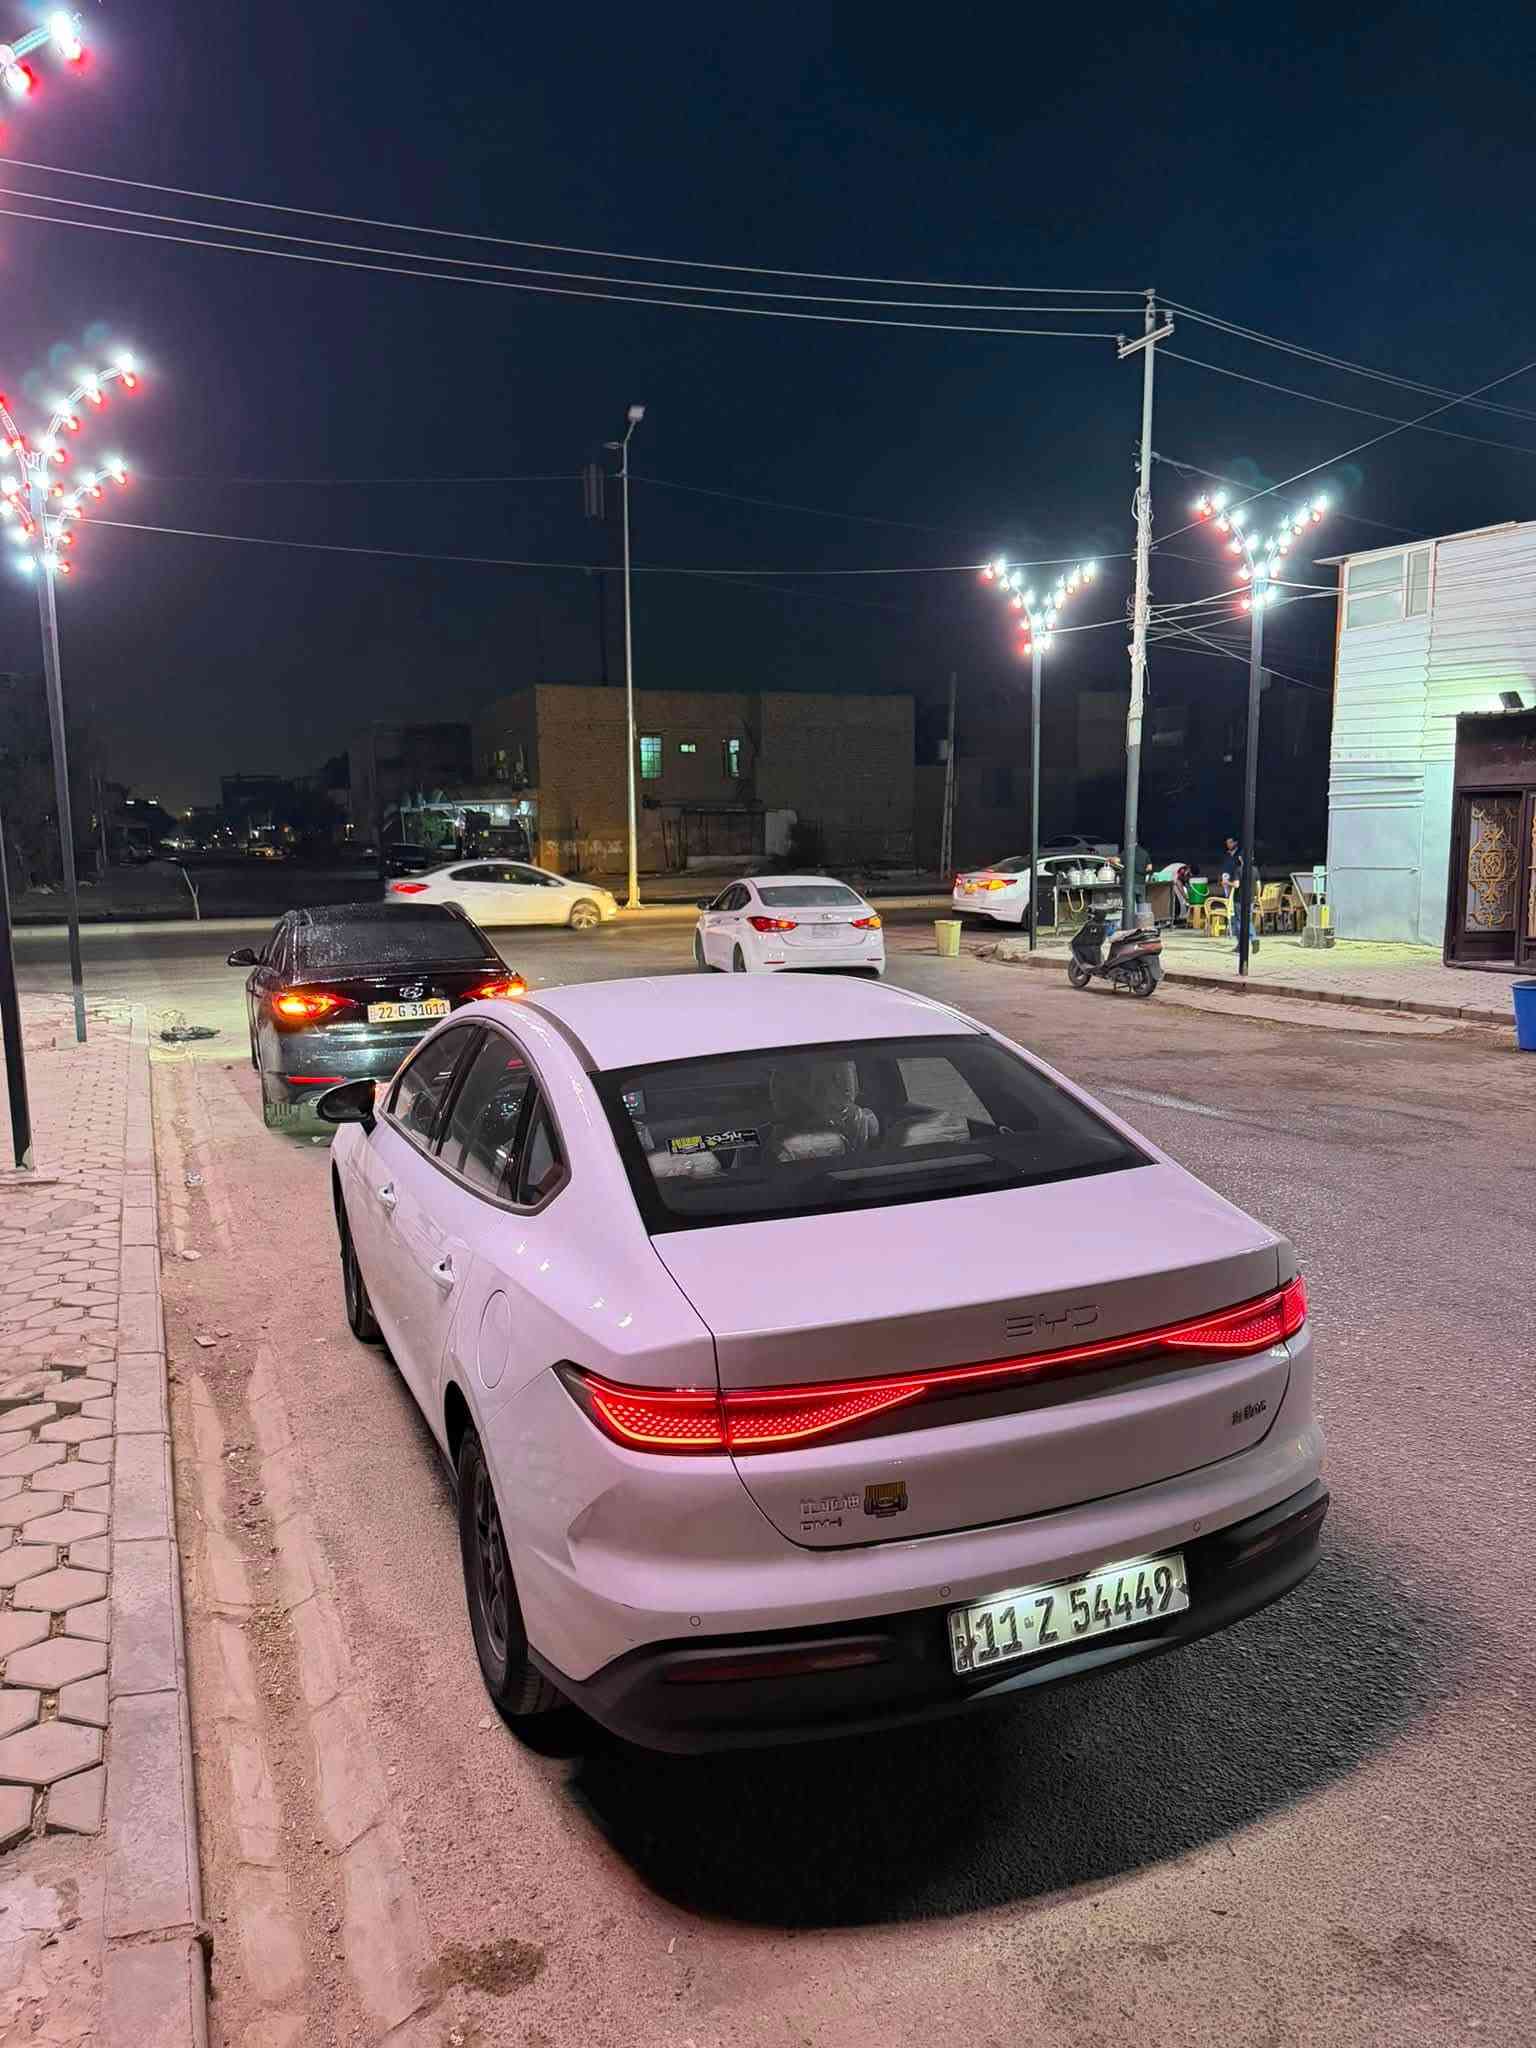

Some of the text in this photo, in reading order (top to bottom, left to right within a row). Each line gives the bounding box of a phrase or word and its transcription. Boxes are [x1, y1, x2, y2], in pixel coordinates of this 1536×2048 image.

[378, 1006, 393, 1019] 22
[398, 1004, 406, 1017] G
[1003, 1304, 1099, 1340] BYD
[975, 1566, 1172, 1659] 11 Z 54449
